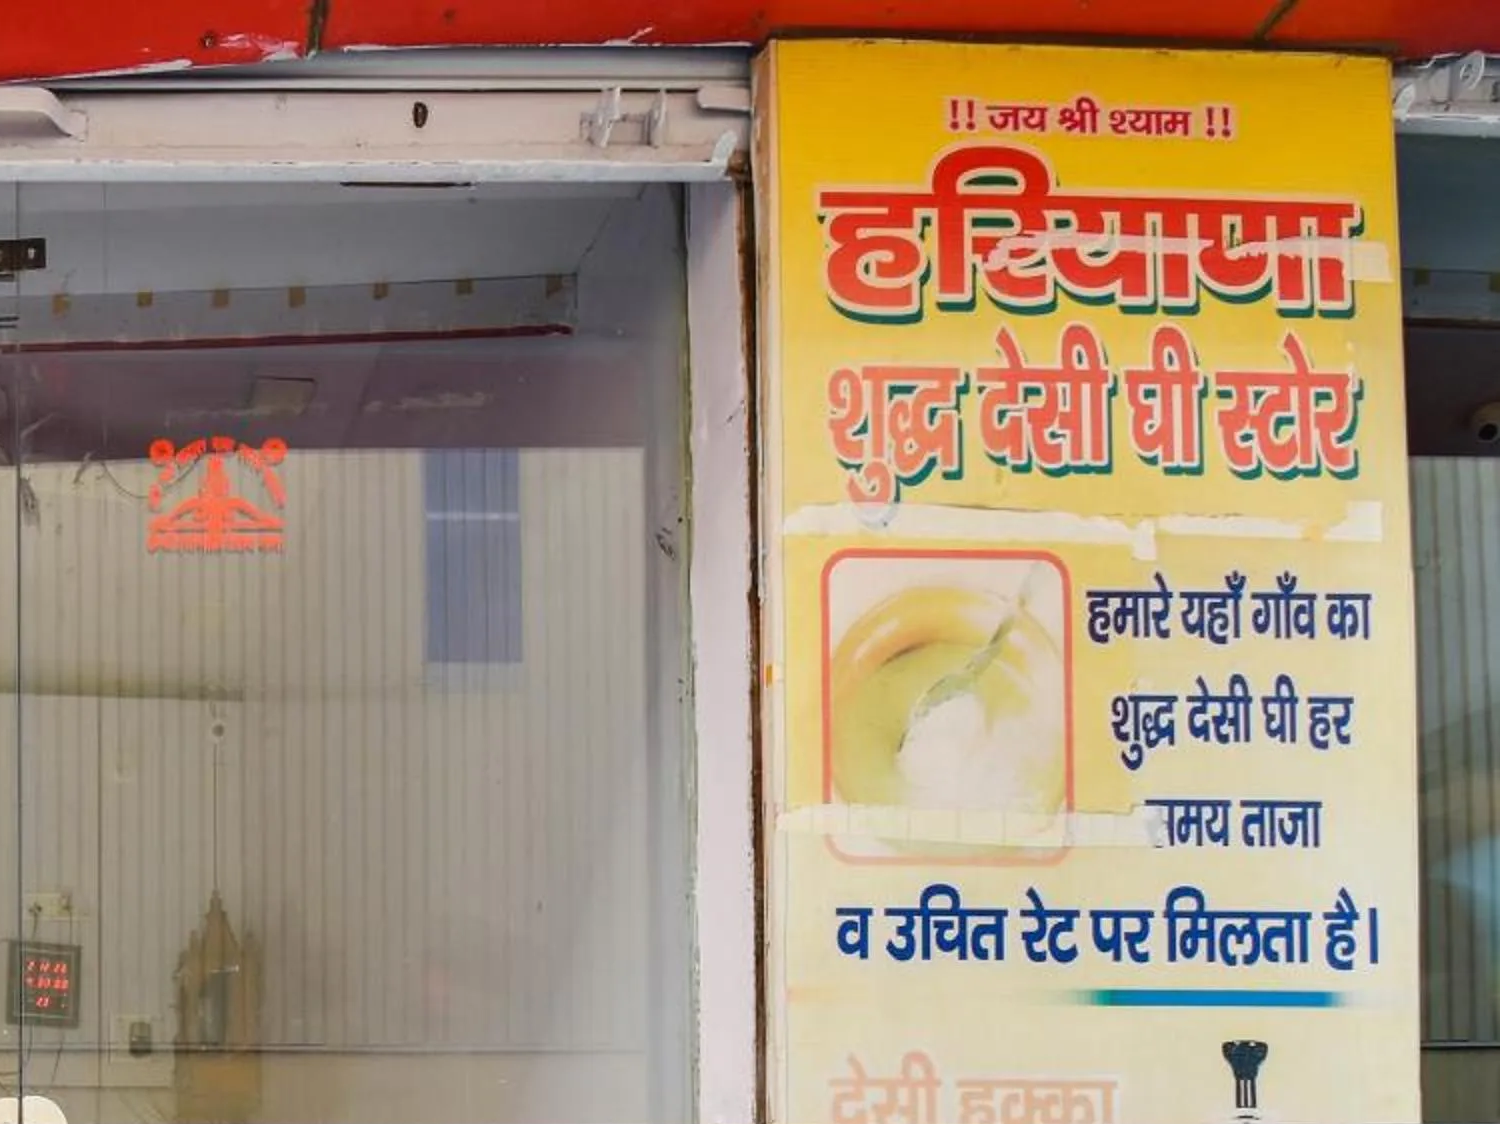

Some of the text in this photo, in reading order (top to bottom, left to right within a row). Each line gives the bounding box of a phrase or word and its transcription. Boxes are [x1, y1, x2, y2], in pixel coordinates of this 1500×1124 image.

[987, 105, 1045, 133] जय
[1057, 98, 1100, 134] श्री
[1109, 108, 1191, 137] श्याम
[817, 144, 1364, 322] हरियाणा
[827, 322, 1362, 506] शुद्ध देसी घी स्टोर
[1087, 570, 1371, 643] हमारे यहाँ गाँव का
[1111, 674, 1354, 770] शुद्ध देसी घी हर
[1240, 800, 1322, 848] ताजा
[836, 907, 871, 960] व
[885, 884, 1008, 962] उचित
[1020, 888, 1078, 963] रेट
[1091, 908, 1153, 963] पर
[1164, 886, 1311, 966] मिलता
